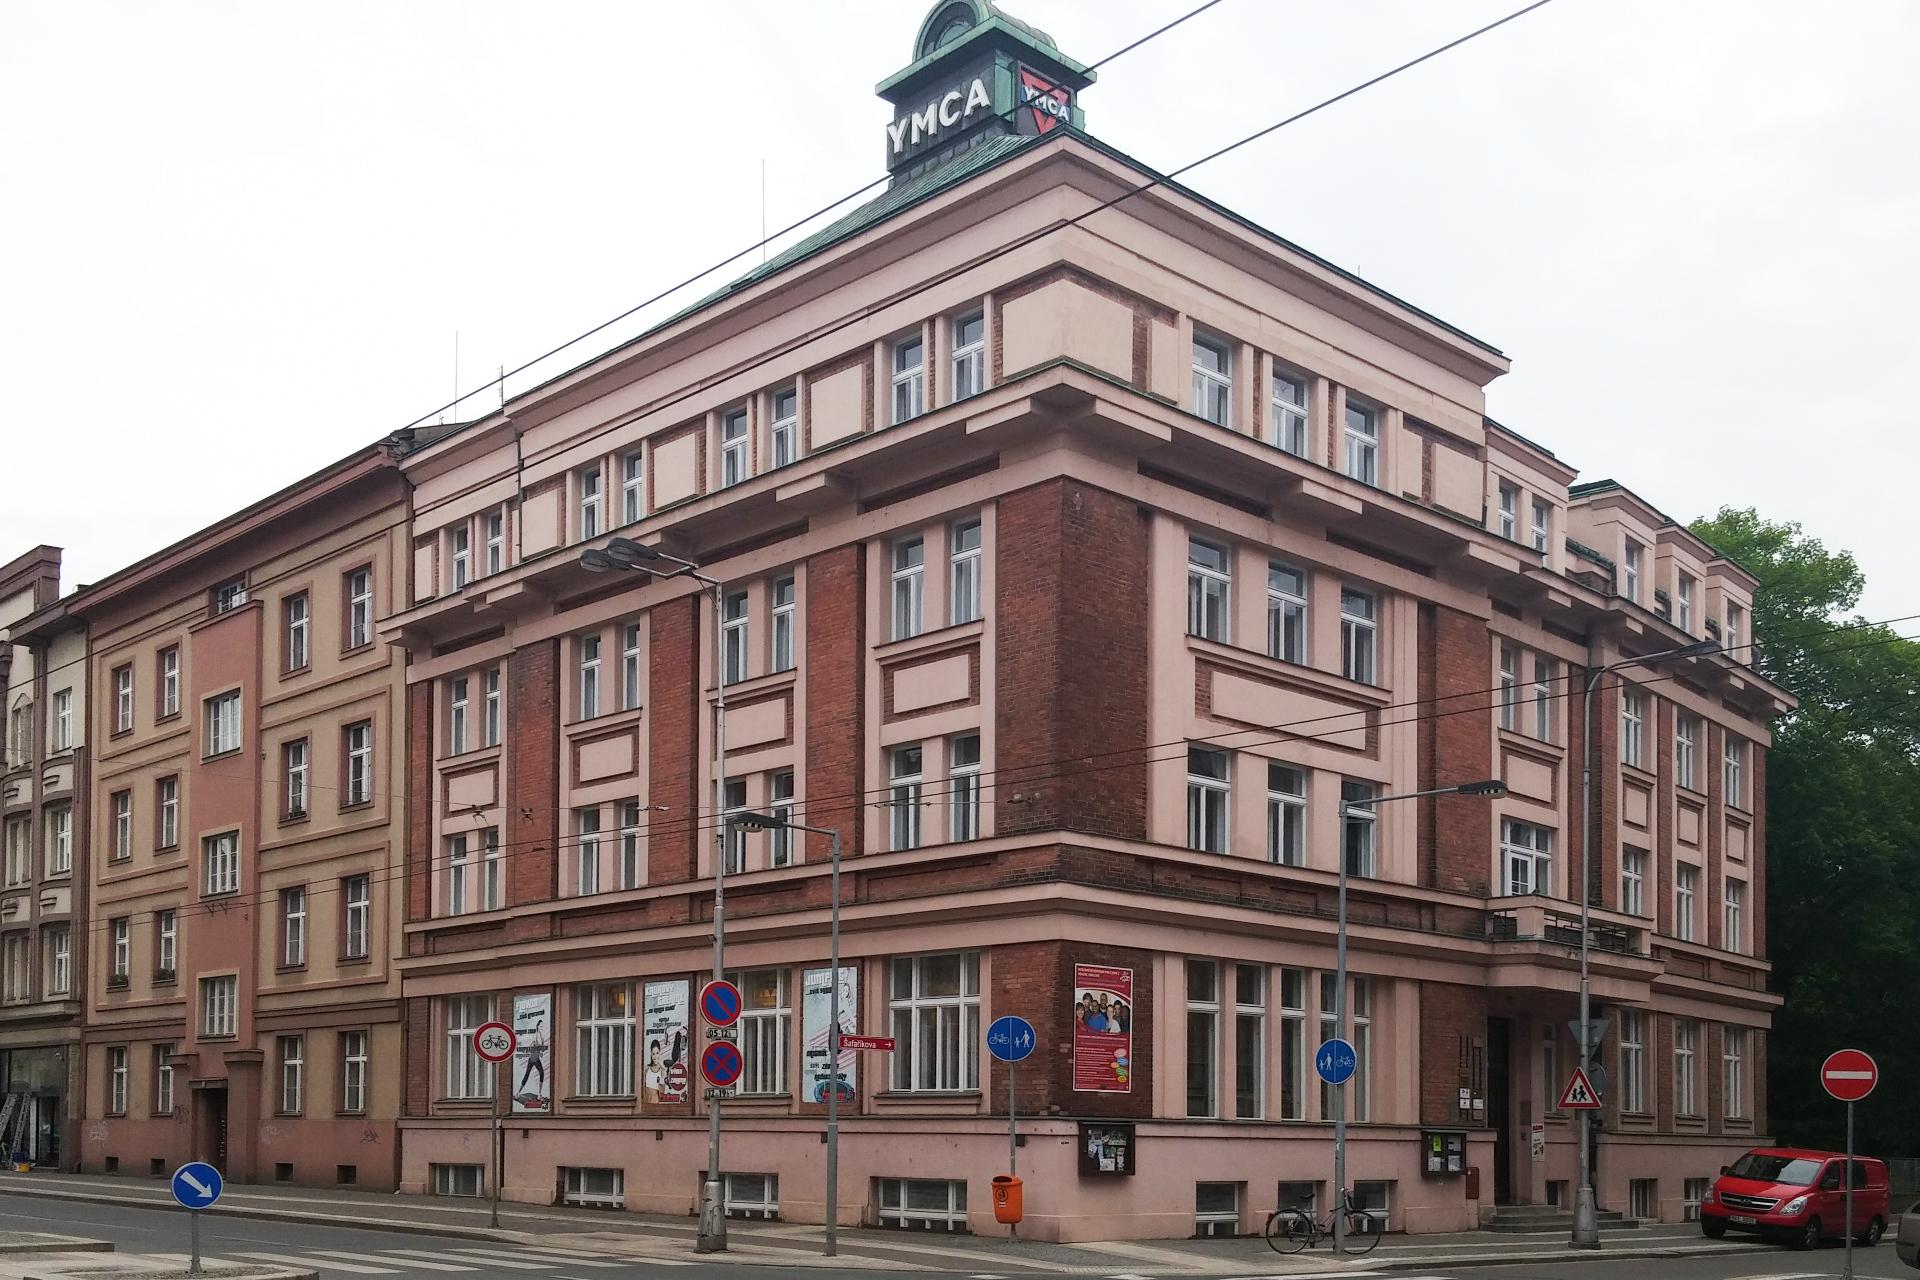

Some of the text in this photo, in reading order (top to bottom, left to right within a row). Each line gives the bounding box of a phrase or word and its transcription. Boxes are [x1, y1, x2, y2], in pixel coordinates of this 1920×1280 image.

[887, 78, 991, 154] YMCA
[1024, 86, 1069, 122] YMCA
[843, 1038, 877, 1049] Šafaříkova
